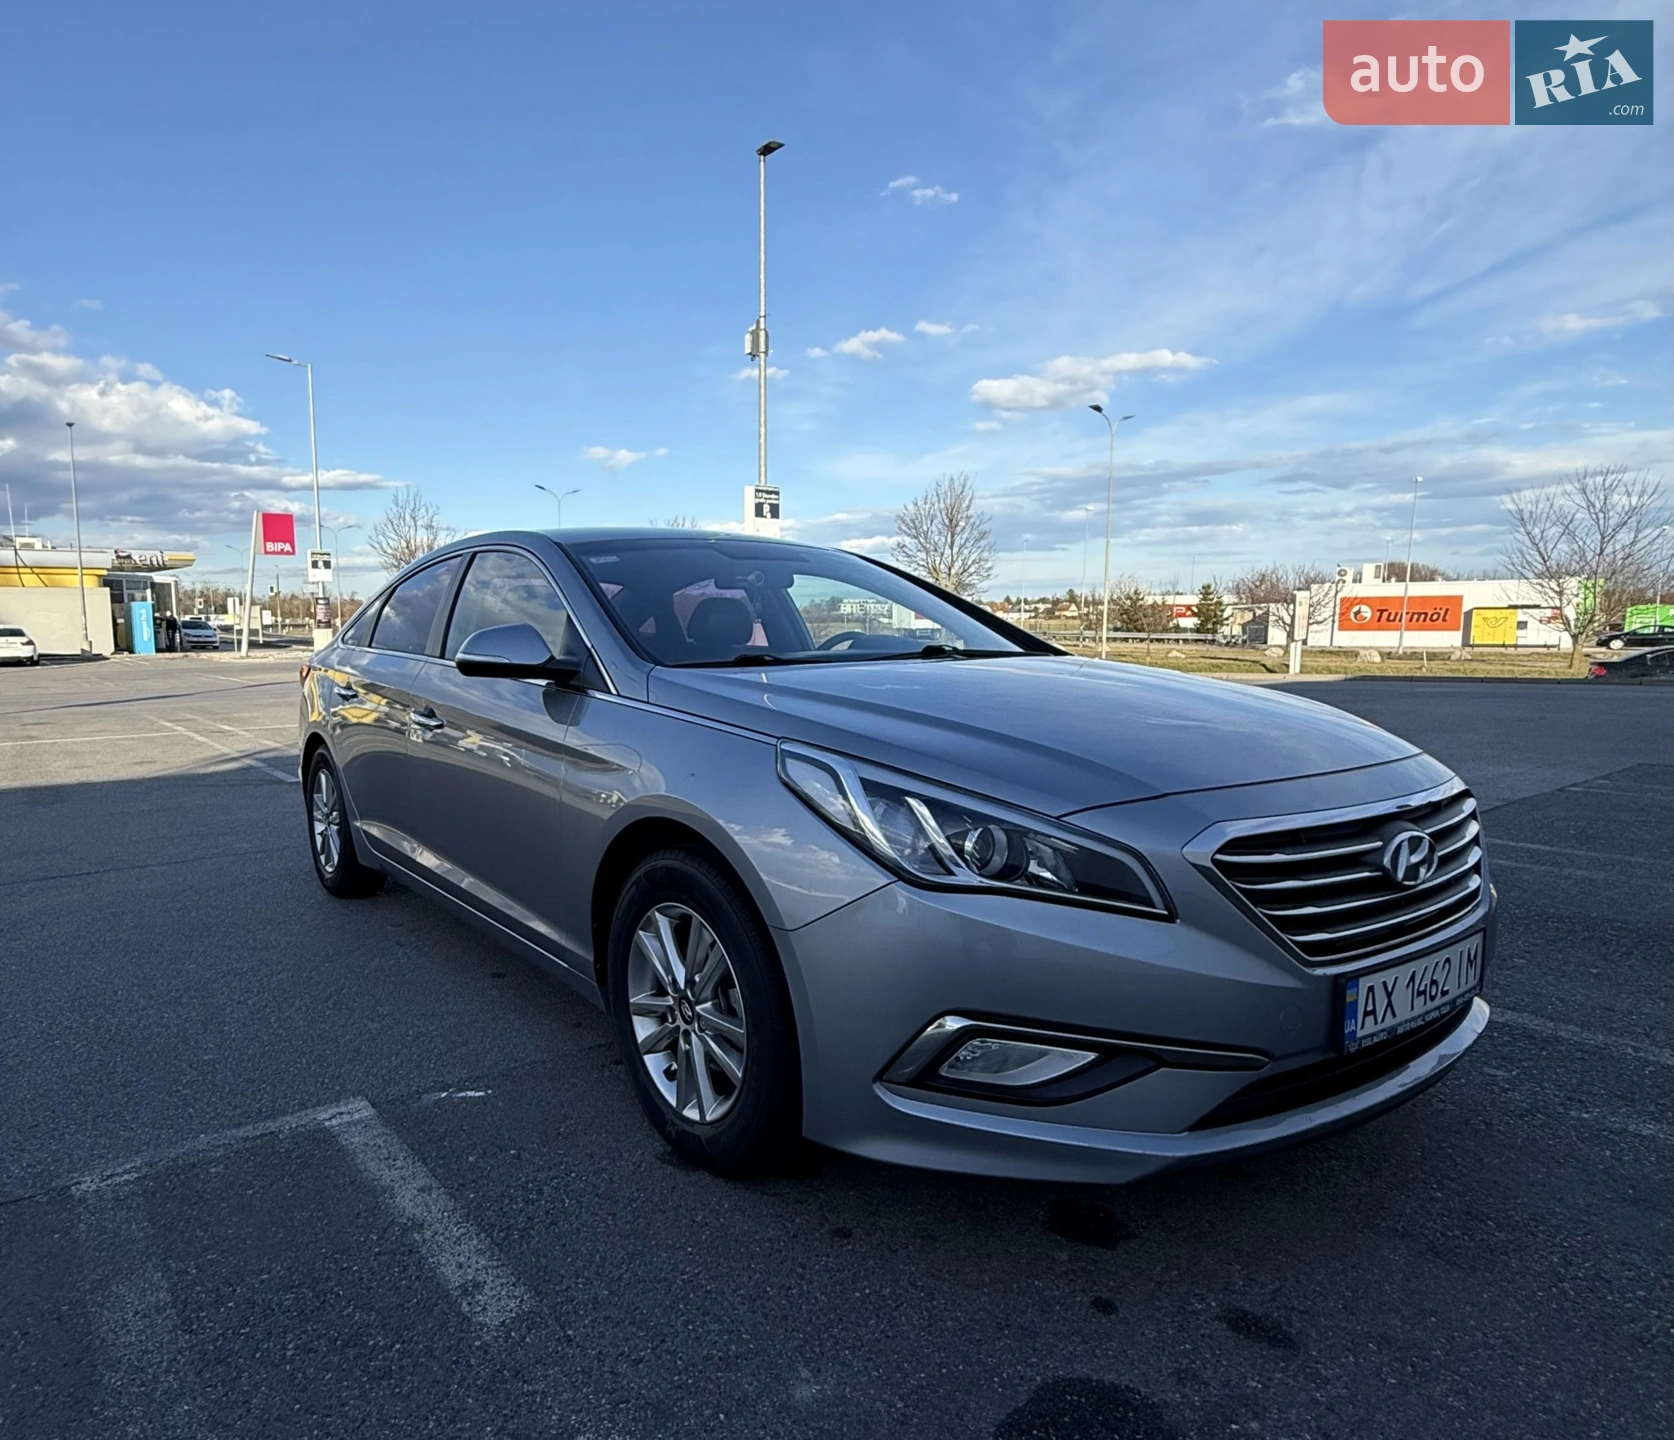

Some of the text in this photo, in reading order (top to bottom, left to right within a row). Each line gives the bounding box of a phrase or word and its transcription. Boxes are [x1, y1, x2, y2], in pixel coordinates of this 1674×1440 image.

[266, 541, 293, 553] BIPA
[138, 550, 167, 567] eni
[1376, 607, 1450, 623] Turmöl
[1359, 976, 1399, 1031] AX
[1404, 954, 1452, 1012] 1462
[1457, 942, 1479, 990] IM
[1344, 1019, 1356, 1034] UA
